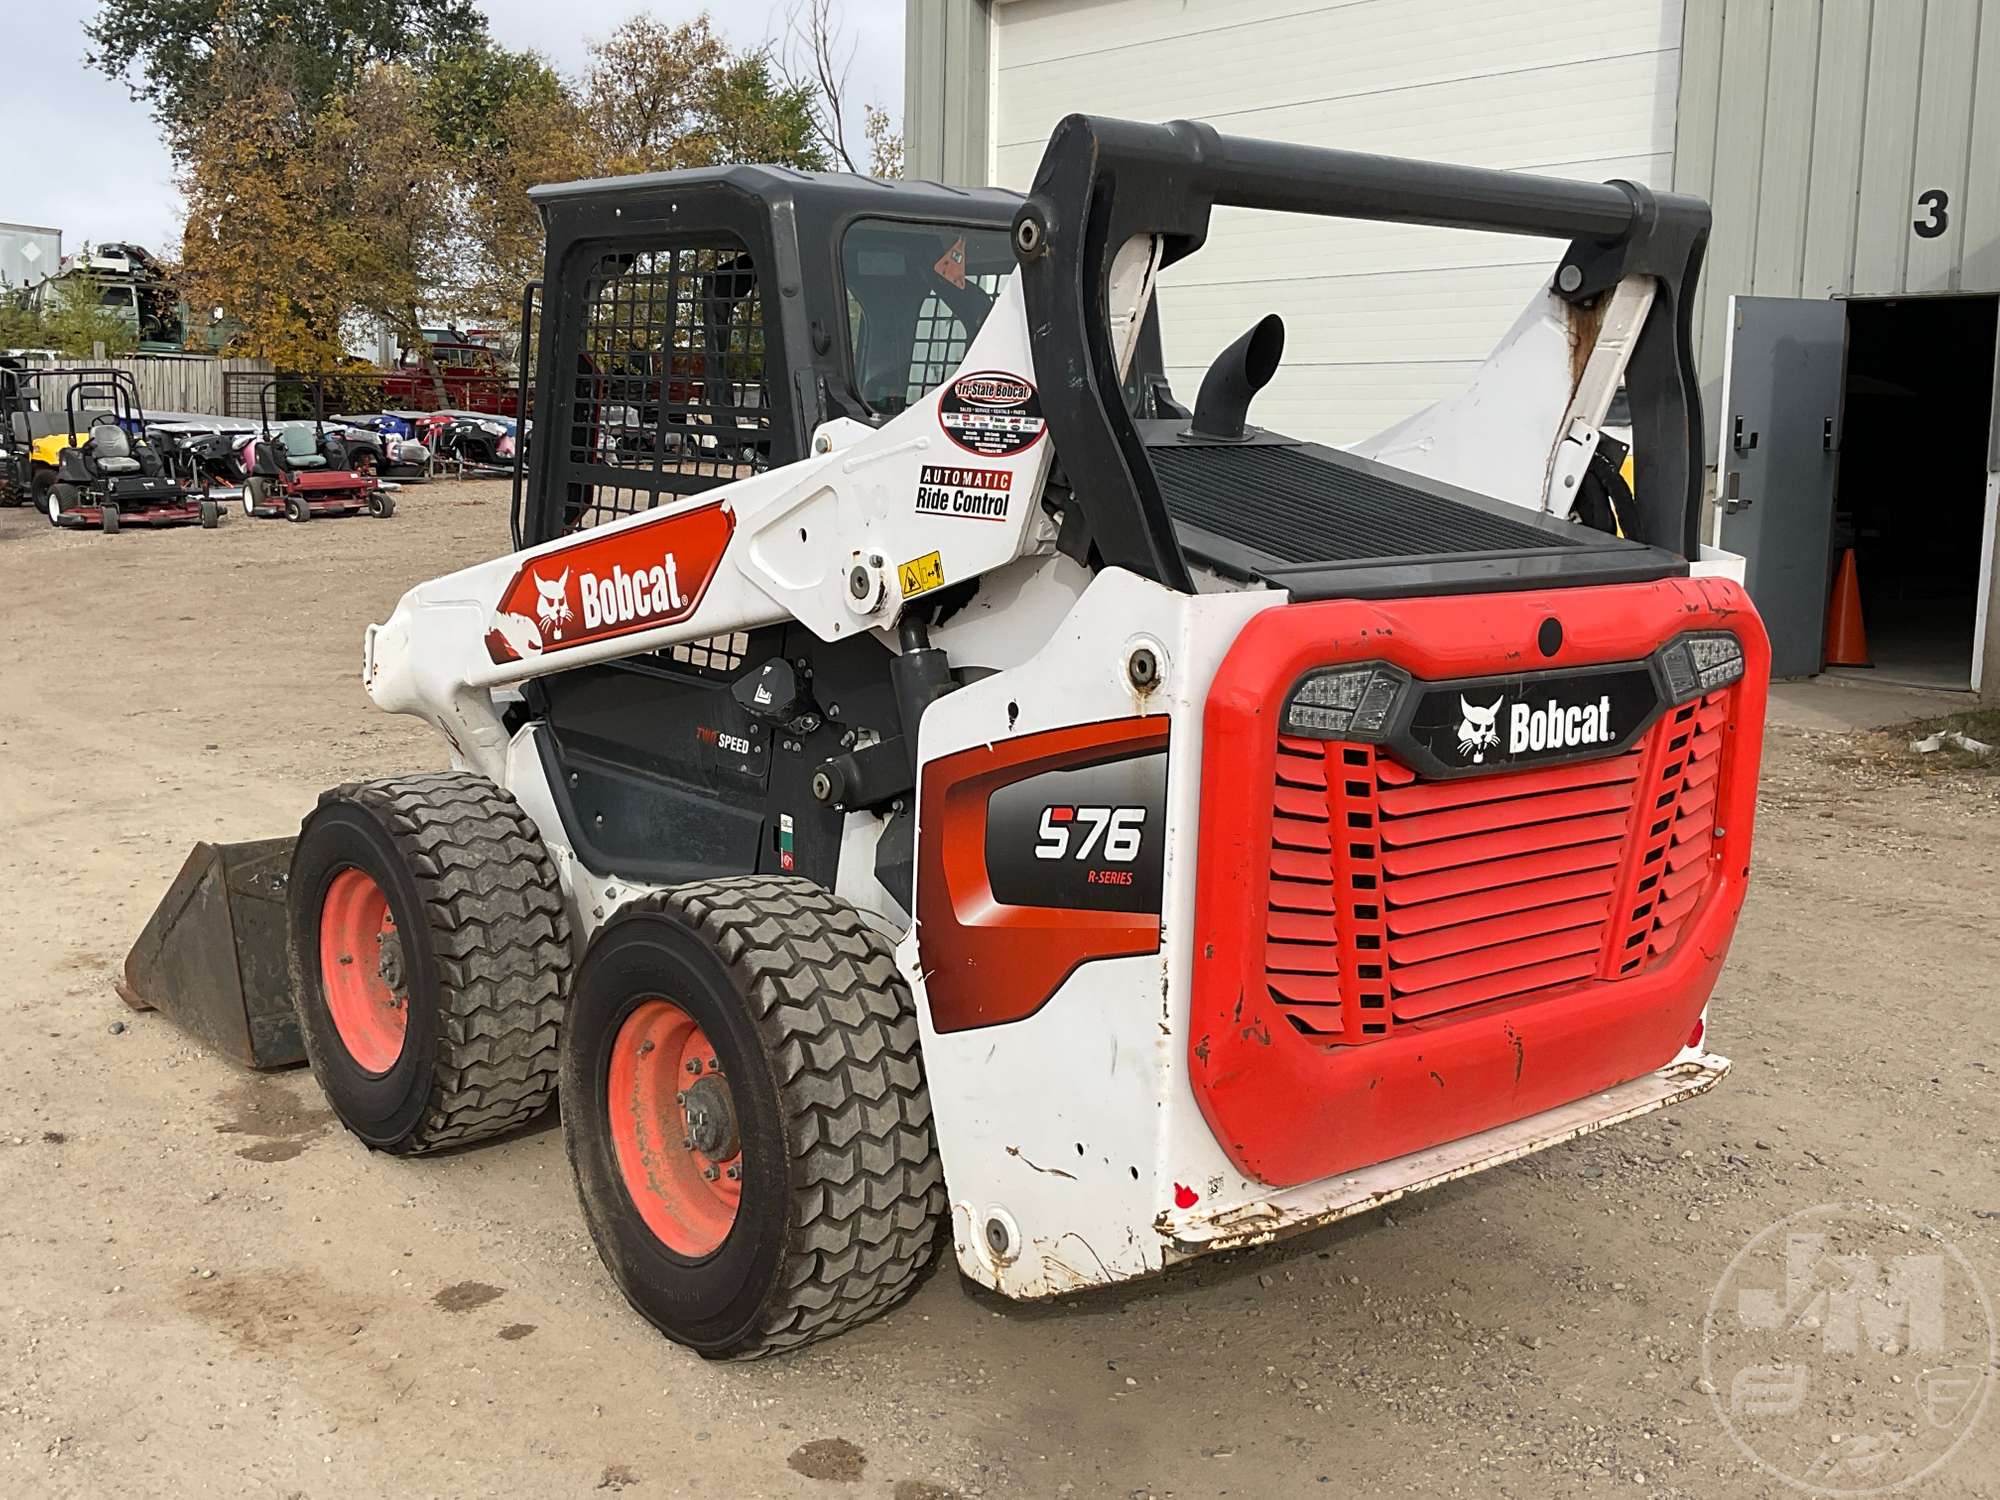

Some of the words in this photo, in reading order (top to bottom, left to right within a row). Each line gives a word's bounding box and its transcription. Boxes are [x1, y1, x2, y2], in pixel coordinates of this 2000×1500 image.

[1914, 189, 1949, 238] 3
[957, 382, 994, 397] Tri-State
[996, 383, 1029, 398] Bobcat
[923, 468, 1009, 489] AUTOMATIC
[916, 486, 949, 511] Ride
[953, 489, 1010, 516] Control
[718, 733, 750, 754] SPEED
[1035, 807, 1146, 861] S76
[1087, 870, 1133, 885] R-SERIES
